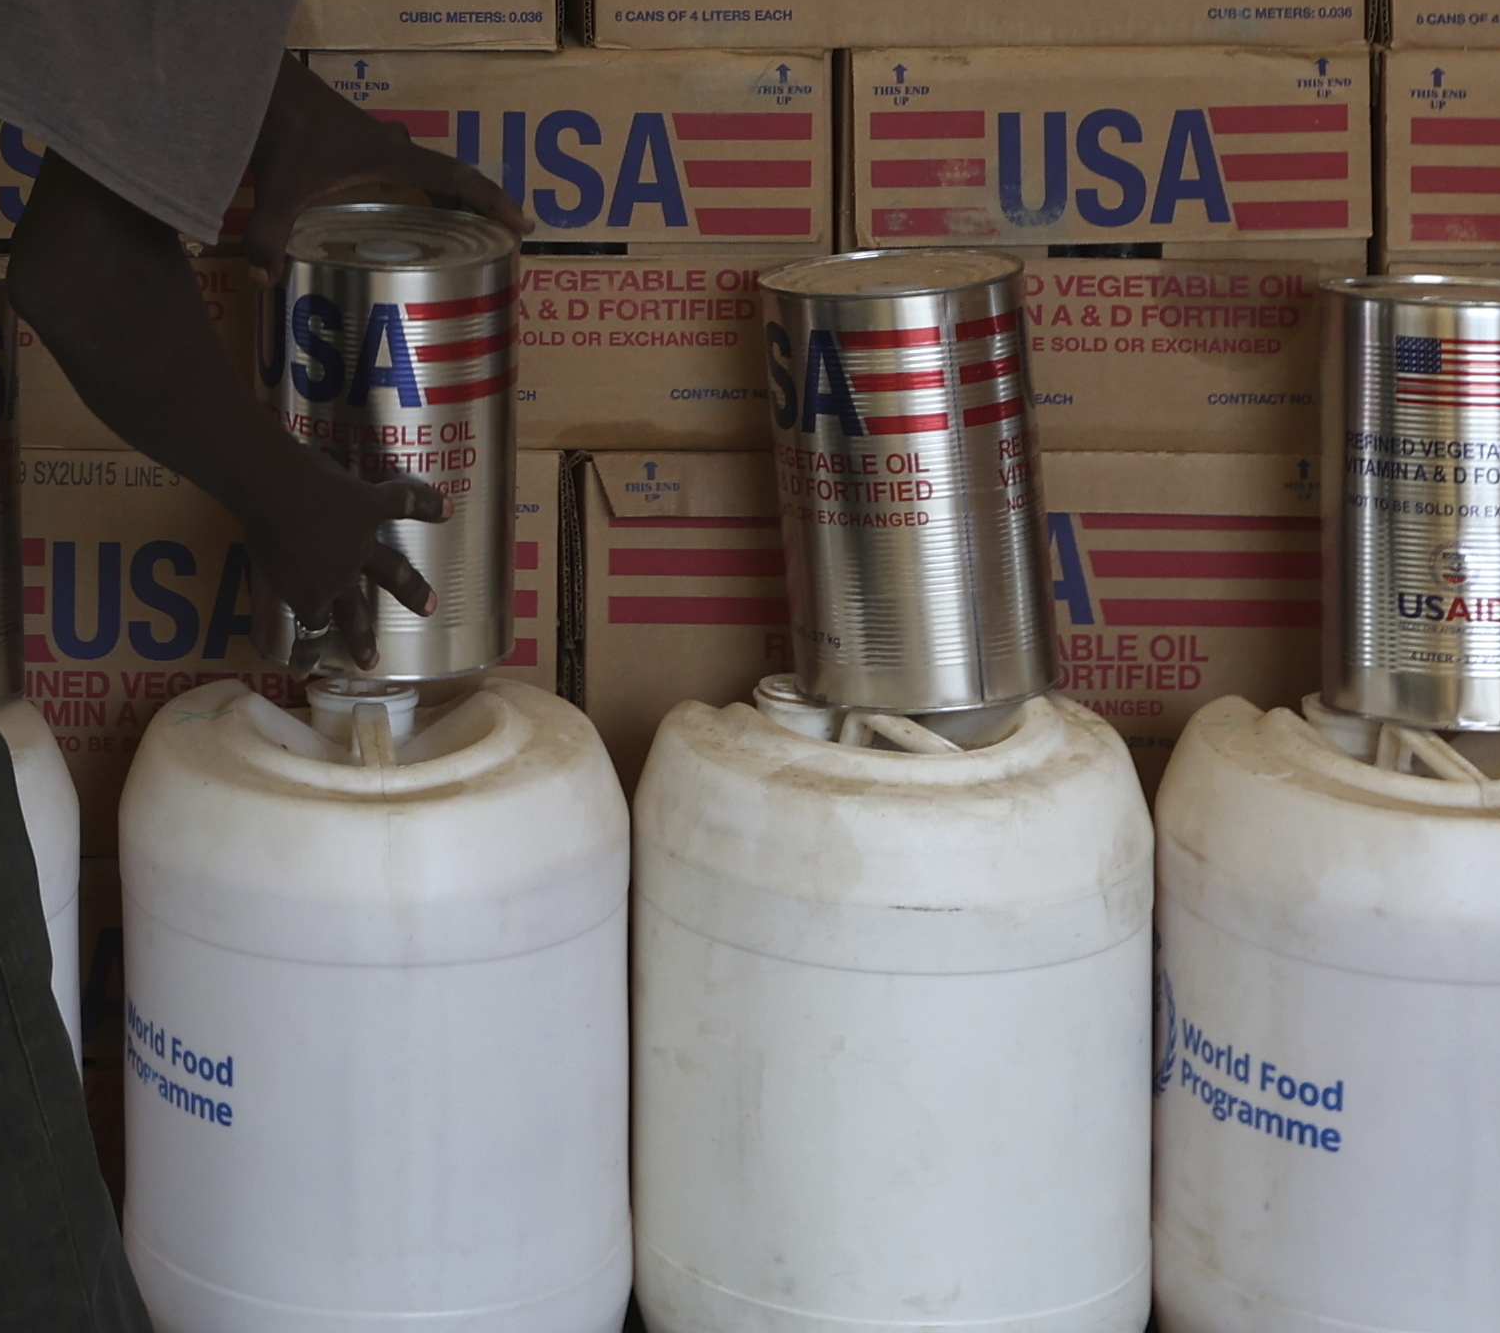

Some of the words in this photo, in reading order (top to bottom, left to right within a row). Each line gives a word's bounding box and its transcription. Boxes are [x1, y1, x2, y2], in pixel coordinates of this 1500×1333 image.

[256, 285, 423, 408] USA
[766, 320, 865, 437] SA
[287, 413, 433, 446] VEGETABLE
[440, 420, 476, 444] OIL
[779, 445, 879, 475] EGETABLE
[885, 452, 930, 475] OIL
[1346, 433, 1415, 457] REFINED
[346, 447, 477, 474] FORTIFIED
[1346, 457, 1408, 480] VITAMIN
[1413, 467, 1428, 482] A
[1433, 467, 1447, 483] &
[1453, 467, 1467, 484] D
[805, 479, 934, 503] FORTIFIED
[818, 511, 930, 527] EXCHANGED
[1373, 497, 1389, 511] TO
[1393, 500, 1410, 514] BE
[1415, 502, 1454, 517] SOLD
[1459, 504, 1480, 518] OR
[127, 994, 165, 1059] World
[171, 1036, 234, 1087] Food
[1182, 1017, 1250, 1084] World
[1260, 1061, 1344, 1112] Food
[1181, 1058, 1342, 1153] Programme
